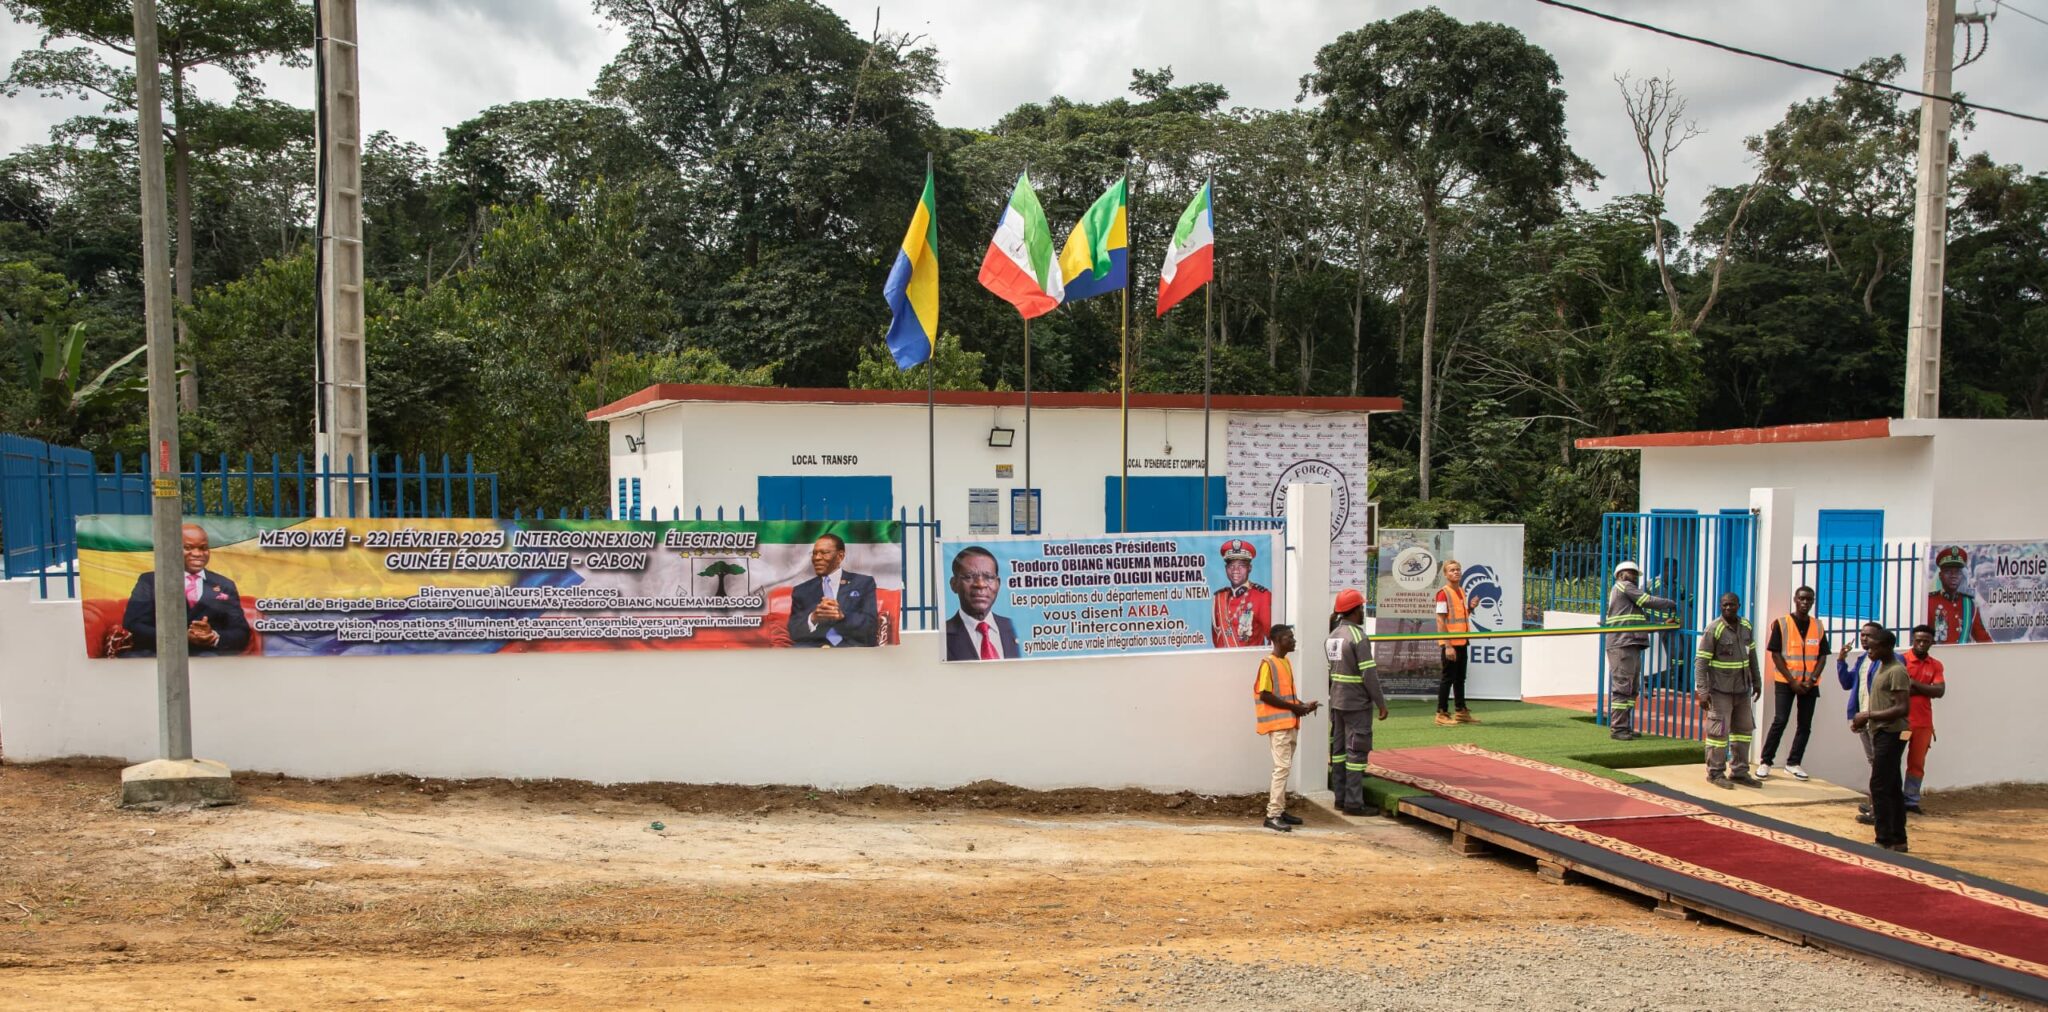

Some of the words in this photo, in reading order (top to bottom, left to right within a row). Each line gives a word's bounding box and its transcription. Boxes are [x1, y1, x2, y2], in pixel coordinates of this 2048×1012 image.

[792, 454, 818, 465] LOCAL
[821, 454, 858, 465] TRANSFO
[1127, 458, 1142, 468] OCAL
[1172, 459, 1180, 469] ET
[1180, 459, 1206, 470] COMPTAG
[1294, 464, 1332, 479] FORCE
[259, 531, 308, 546] MEYO
[311, 529, 345, 546] KYÉ
[366, 532, 388, 546] 22
[391, 529, 457, 546] FÉVRIER
[461, 532, 503, 547] 2025
[514, 532, 655, 547] INTERCONNEXION
[665, 529, 756, 547] ÉLECTRIQUE
[1043, 543, 1113, 556] Excellences
[1115, 541, 1177, 554] Présidents
[386, 549, 450, 569] GUINÉE
[455, 549, 568, 569] ÉQUATORIALE
[586, 553, 645, 569] GABON
[1011, 560, 1059, 573] Teodoro
[1061, 558, 1104, 572] OBIANG
[1106, 557, 1151, 570] NGUEMA
[1153, 555, 1206, 569] MBAZOGO
[1996, 554, 2047, 577] Monsie
[1008, 576, 1022, 588] et
[1024, 575, 1059, 588] Brice
[1061, 573, 1111, 587] Clotaire
[1113, 571, 1153, 585] OLIGUI
[1155, 570, 1206, 583] NGUEMA,
[420, 587, 490, 598] Bienvenue
[494, 587, 501, 597] à
[505, 587, 540, 597] Leurs
[543, 586, 617, 597] Excellences
[1012, 593, 1028, 606] Les
[1030, 591, 1088, 607] populations
[1090, 590, 1104, 603] du
[1106, 588, 1168, 604] département
[1170, 587, 1183, 600] du
[1185, 586, 1210, 599] NTEM
[256, 599, 304, 609] Général
[306, 599, 323, 609] de
[325, 599, 372, 611] Brigade
[375, 599, 405, 609] Brice
[408, 599, 456, 608] Clotaire
[456, 599, 496, 608] OLIGUI
[498, 598, 549, 608] NGUEMA
[551, 598, 560, 608] &
[562, 598, 607, 608] Teodoro
[608, 598, 653, 607] OBIANG
[655, 598, 704, 607] NGUEMA
[706, 597, 761, 607] MBASOGO
[1043, 610, 1077, 621] vous
[1081, 605, 1124, 619] disent
[1127, 604, 1169, 618] AKIBA
[254, 620, 291, 630] Grâce
[293, 620, 301, 630] à
[303, 620, 335, 630] votre
[337, 618, 376, 630] vision,
[379, 620, 400, 629] nos
[402, 618, 446, 629] nations
[448, 618, 515, 628] s'illuminent
[518, 619, 529, 628] et
[532, 619, 583, 628] avancent
[585, 617, 639, 627] ensemble
[641, 618, 663, 627] vers
[666, 618, 680, 627] un
[682, 616, 716, 626] avenir
[717, 616, 761, 626] meilleur
[1033, 624, 1067, 638] pour
[1071, 617, 1188, 634] l'interconnexion,
[1989, 612, 2014, 628] rurales
[2016, 615, 2034, 627] vous
[339, 629, 372, 639] Merci
[375, 630, 403, 641] pour
[405, 629, 435, 639] cette
[437, 628, 485, 638] avancée
[488, 627, 545, 639] historique
[546, 628, 561, 637] au
[563, 627, 603, 637] service
[605, 627, 619, 636] de
[621, 627, 641, 636] nos
[643, 627, 686, 638] peuples
[1024, 638, 1059, 654] symbole
[1061, 637, 1084, 650] d'une
[1085, 636, 1105, 649] vraie
[1106, 634, 1148, 650] intégration
[1150, 635, 1167, 646] sous
[1168, 631, 1206, 648] régionale.
[1471, 646, 1513, 664] EEG
